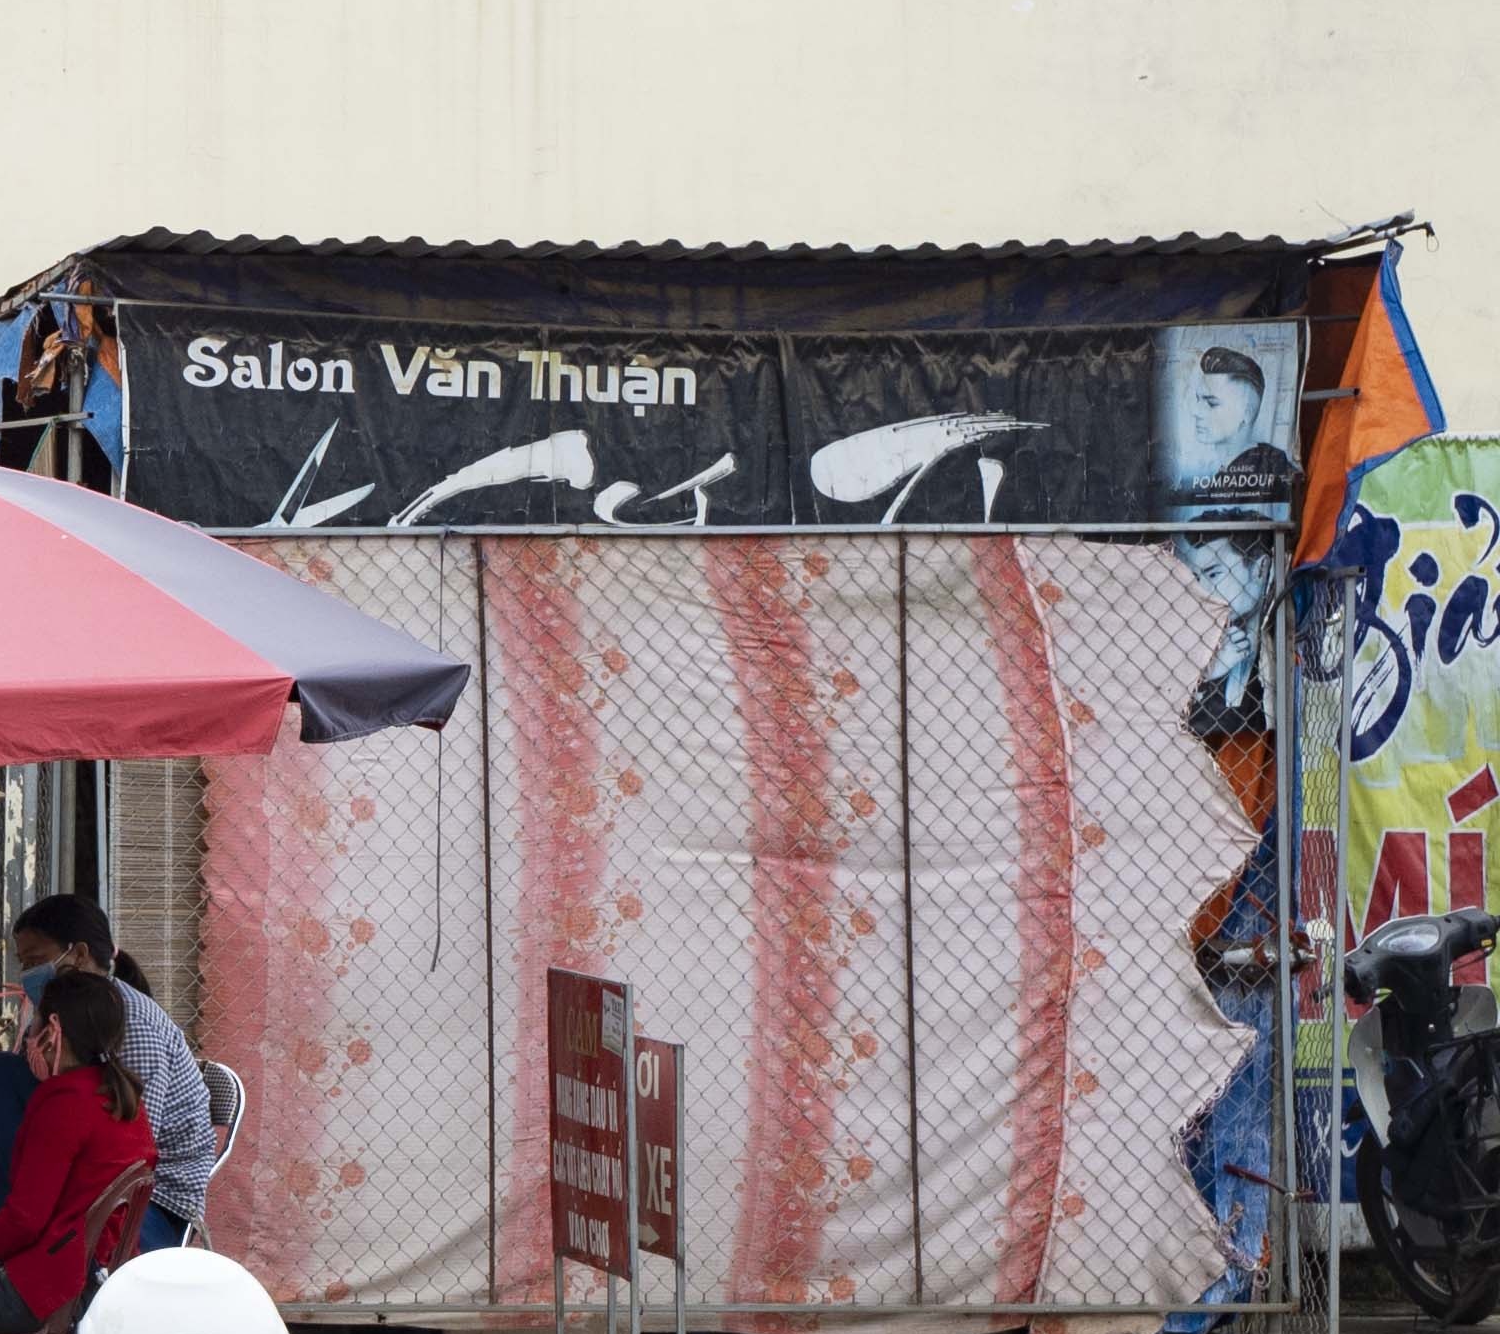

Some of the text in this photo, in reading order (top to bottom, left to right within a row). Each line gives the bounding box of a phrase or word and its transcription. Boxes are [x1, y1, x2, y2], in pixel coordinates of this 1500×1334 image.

[182, 336, 697, 418] Salon Văn Thuận
[1192, 474, 1275, 489] POMPADOUR
[637, 1049, 660, 1100] ƠI
